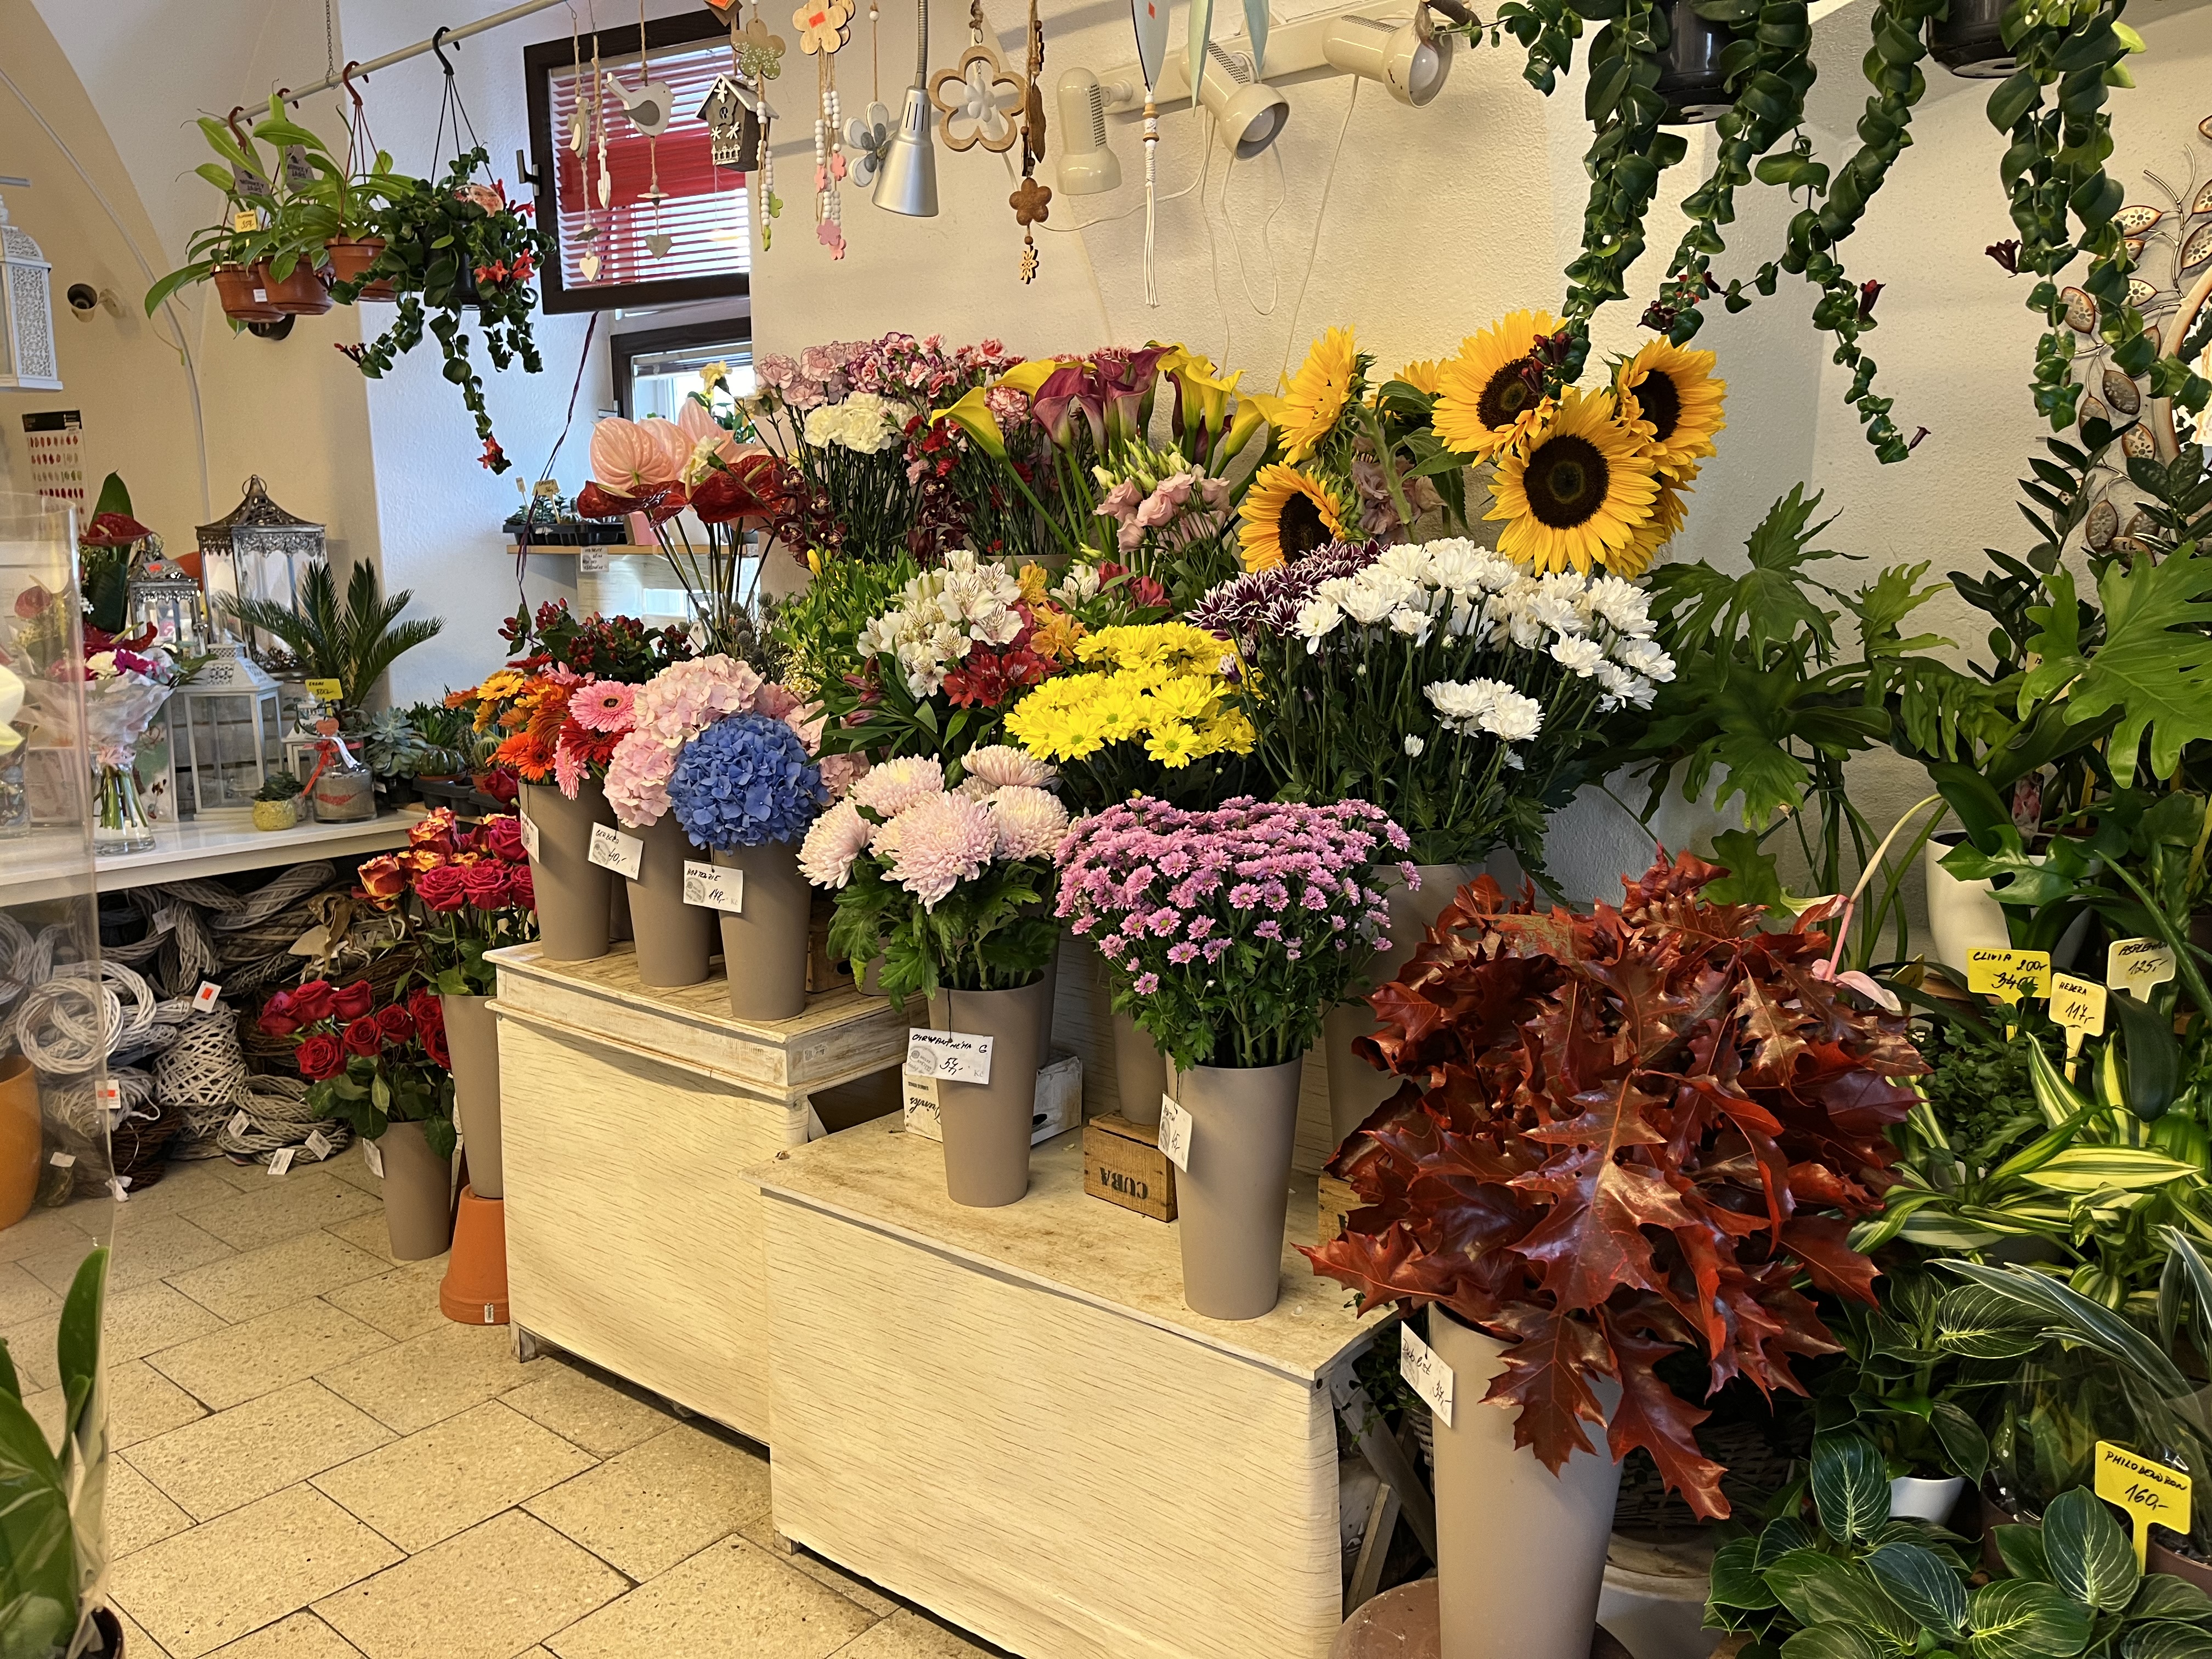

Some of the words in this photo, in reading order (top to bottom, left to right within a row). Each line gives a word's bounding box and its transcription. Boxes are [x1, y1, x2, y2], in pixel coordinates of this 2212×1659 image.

[1973, 951, 2012, 962] CLIVIA
[2058, 981, 2087, 996] HEDERA
[1099, 1167, 1148, 1200] CUBA
[2125, 1483, 2169, 1511] 160,-
